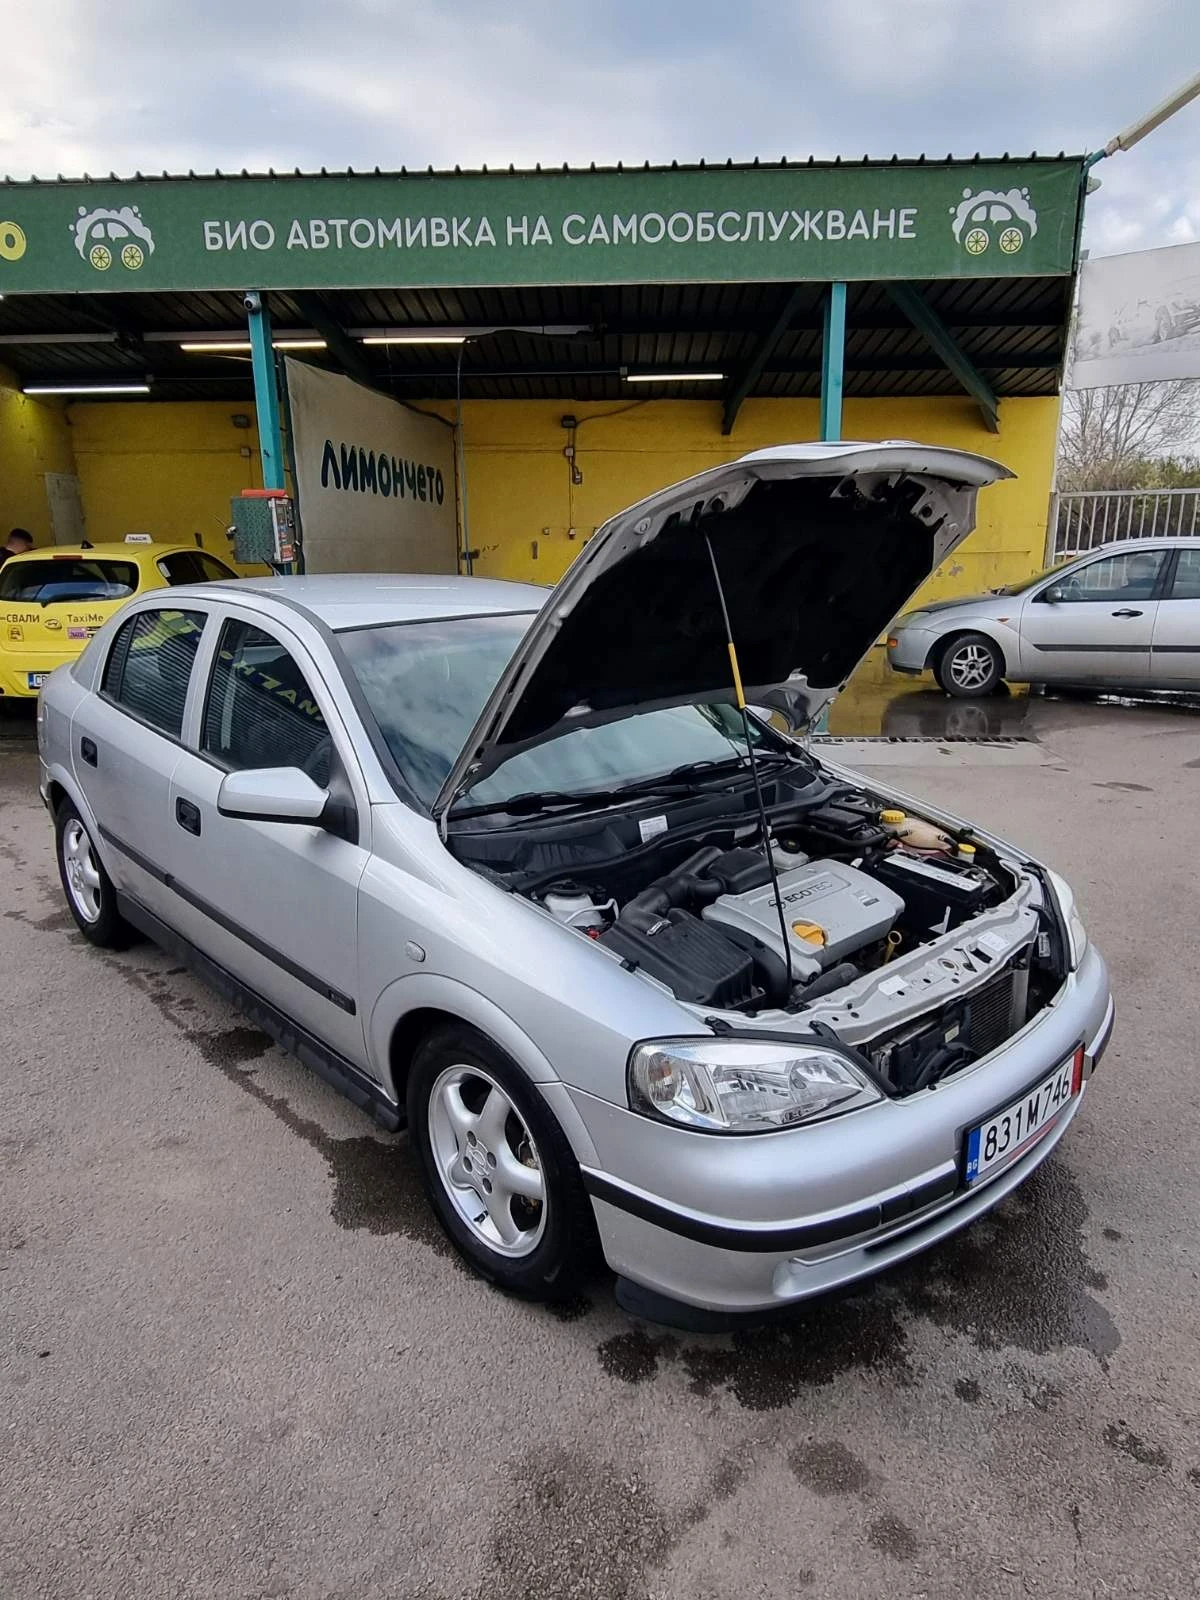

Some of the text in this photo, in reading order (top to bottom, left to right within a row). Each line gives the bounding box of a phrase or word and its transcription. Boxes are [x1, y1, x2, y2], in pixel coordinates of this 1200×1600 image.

[203, 208, 918, 251] БИО АВТОМИВКА НА САМООБСЛУЖВАНЕ
[67, 614, 104, 623] TaxiMe
[784, 880, 833, 904] ECOTEC
[966, 1159, 978, 1173] BG
